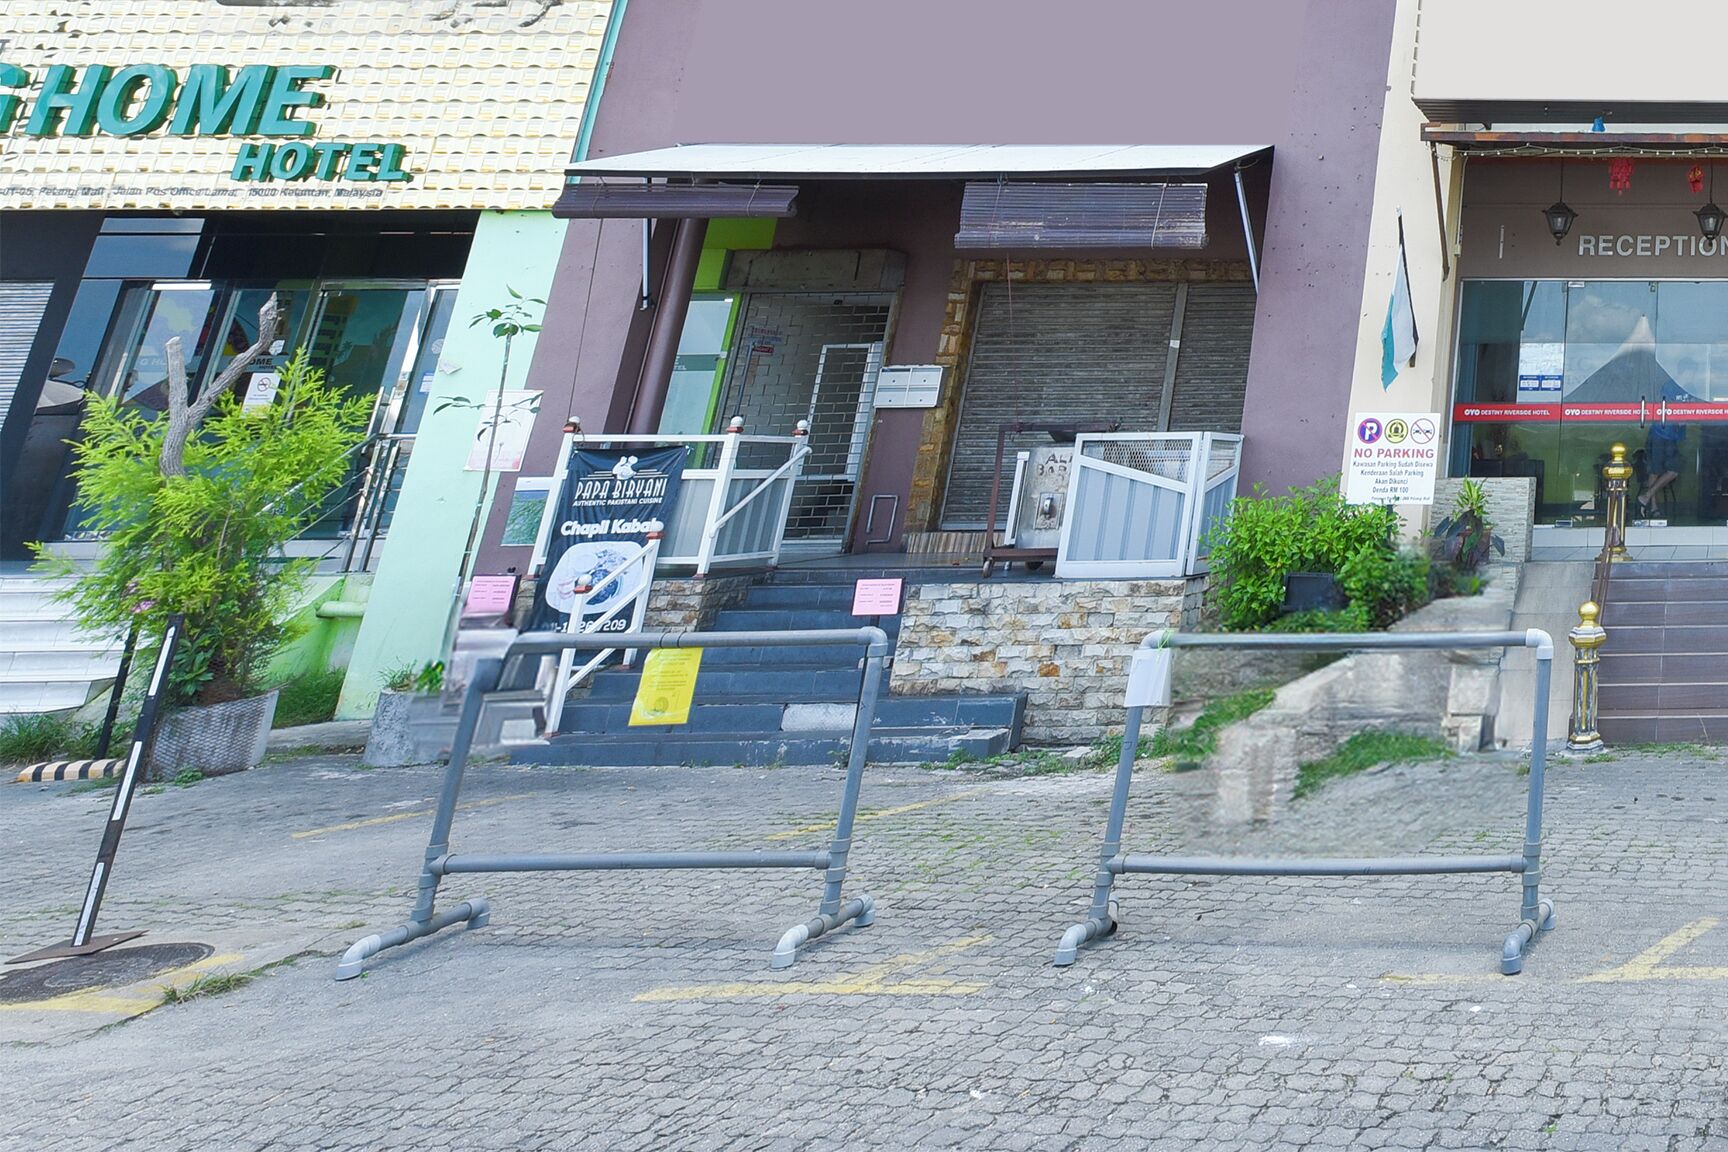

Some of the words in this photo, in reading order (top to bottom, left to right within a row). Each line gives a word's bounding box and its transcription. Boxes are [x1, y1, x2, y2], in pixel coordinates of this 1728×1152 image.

[230, 142, 413, 183] HOTEL
[247, 358, 273, 366] OME
[1354, 448, 1372, 458] NO
[1377, 448, 1434, 459] PARKING
[574, 480, 610, 500] PAPA
[612, 478, 668, 499] BIRYANI
[572, 499, 606, 507] AUTHENTIC
[607, 498, 637, 506] PAKISTANI
[561, 519, 610, 538] Chapli
